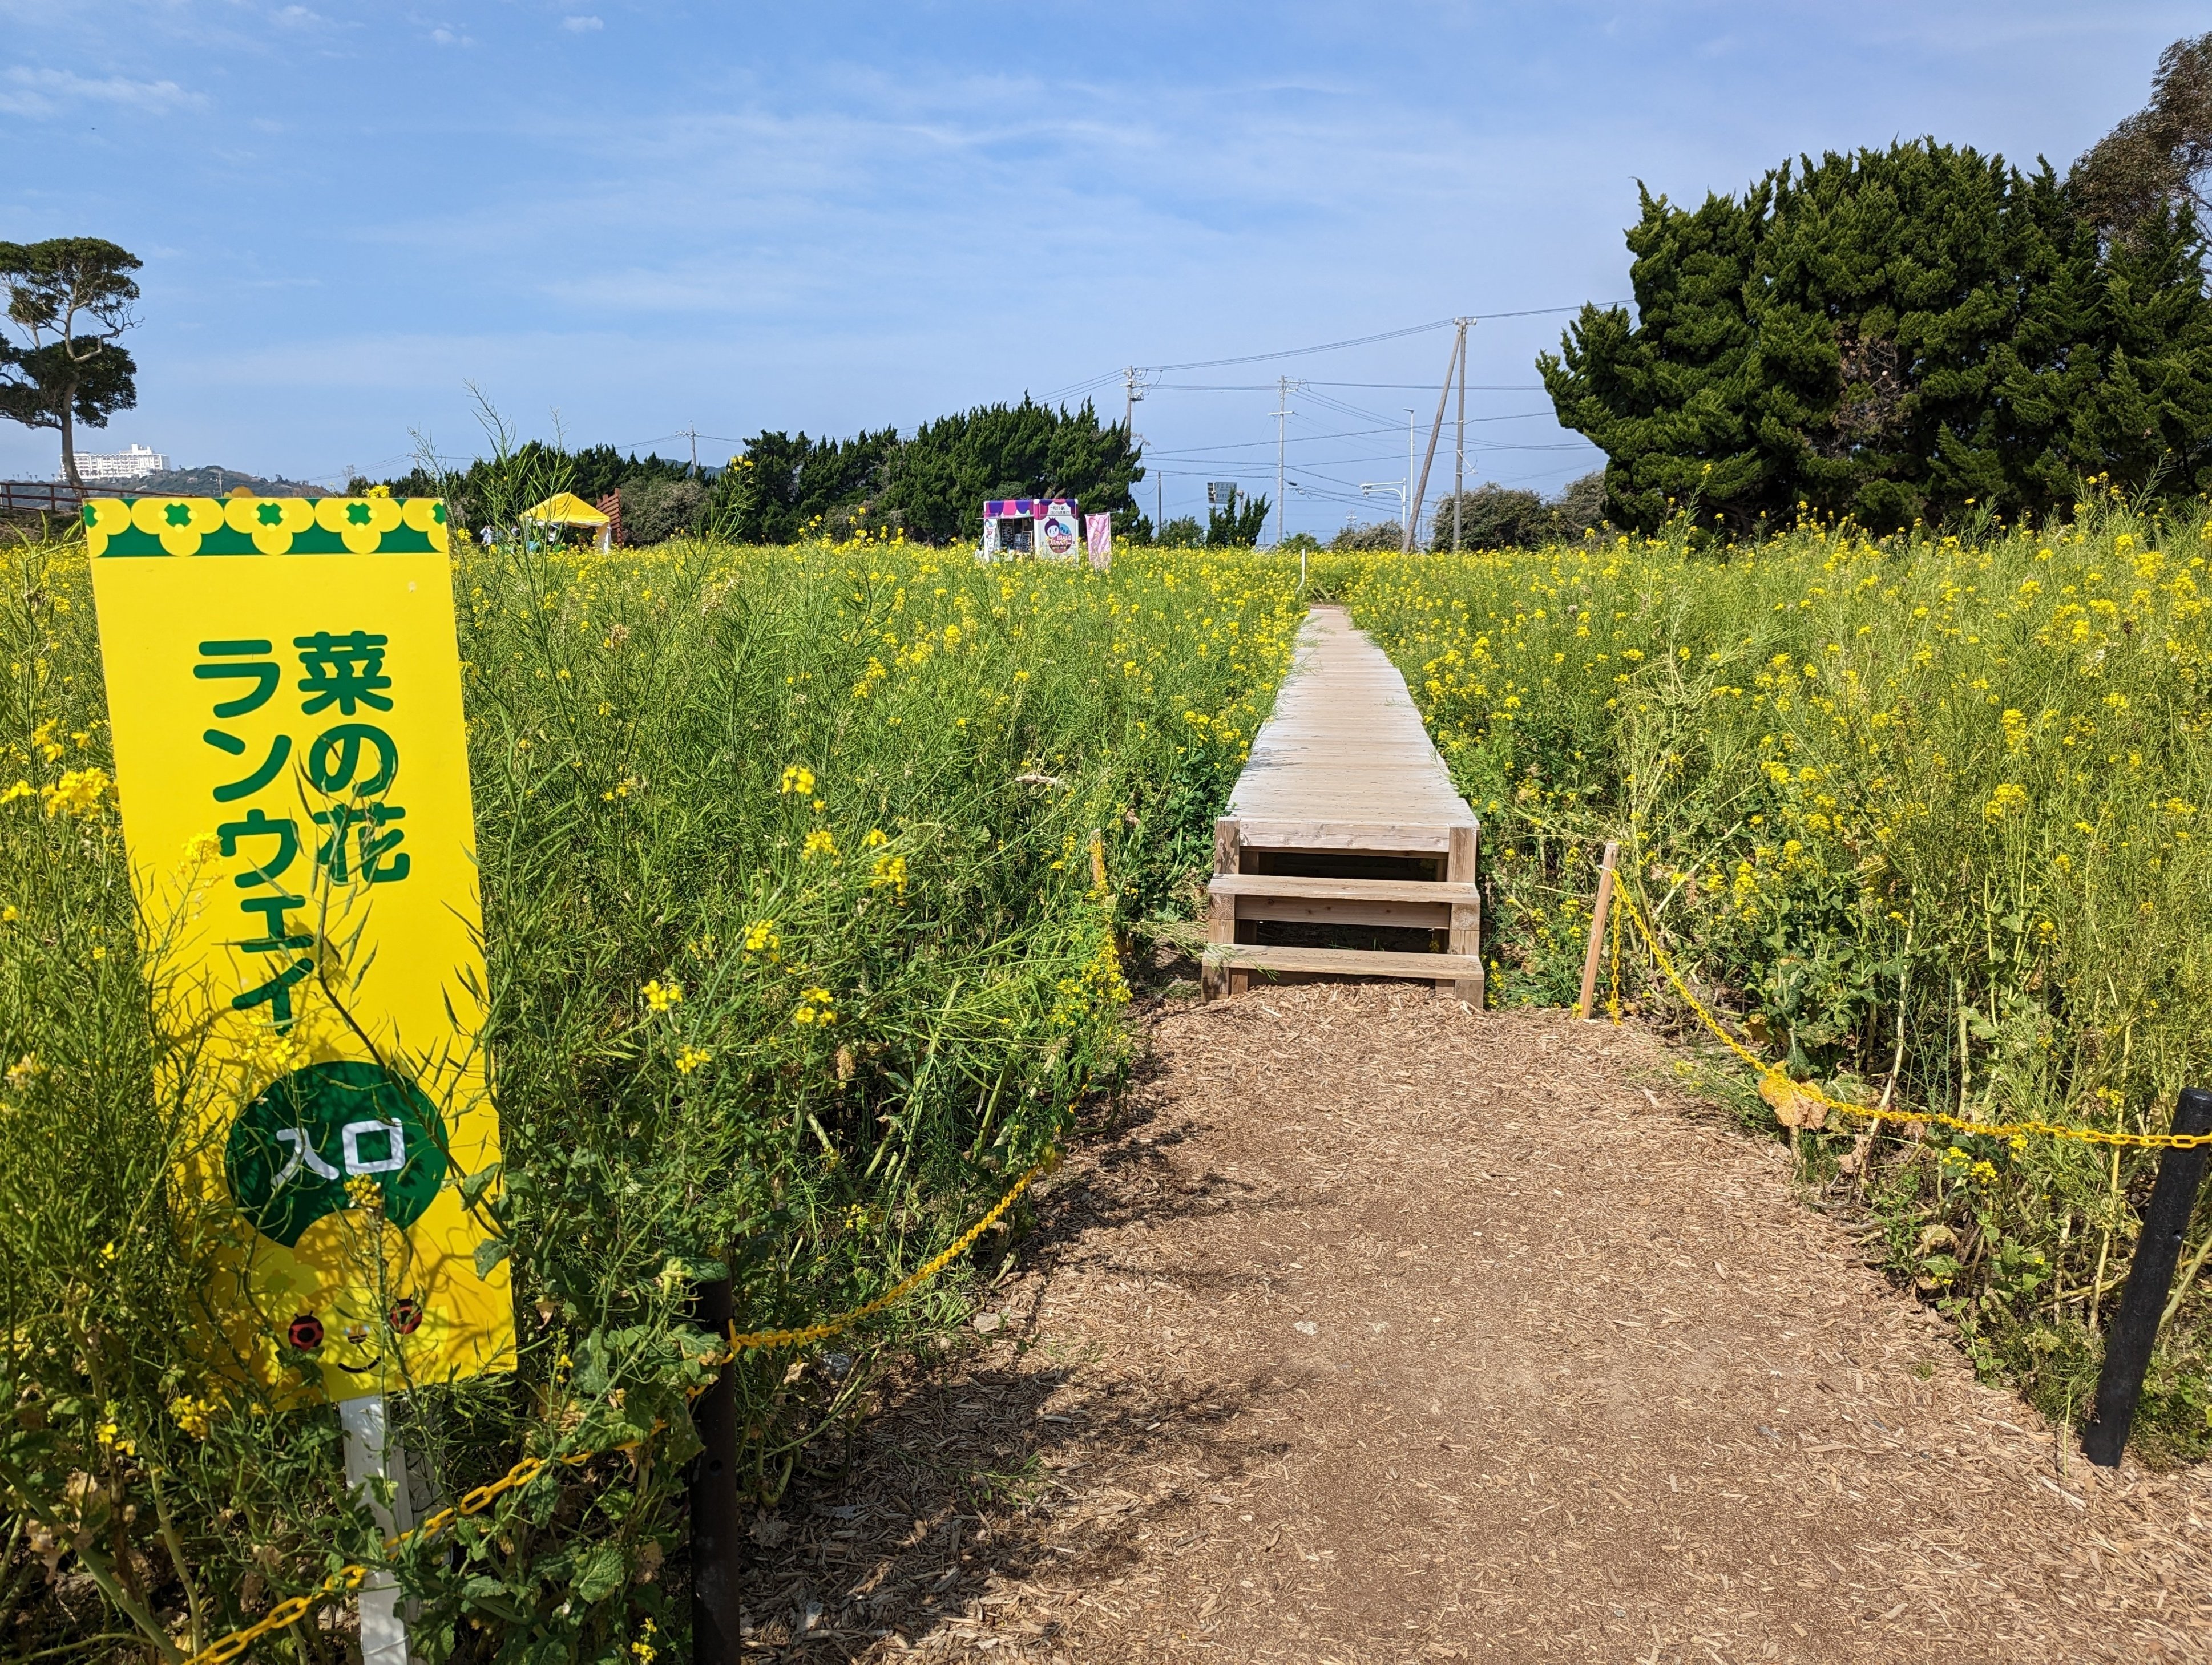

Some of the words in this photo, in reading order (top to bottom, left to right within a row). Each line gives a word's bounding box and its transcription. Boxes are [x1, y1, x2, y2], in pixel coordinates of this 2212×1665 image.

[293, 630, 411, 887] 菜の花
[271, 1117, 406, 1186] 入口
